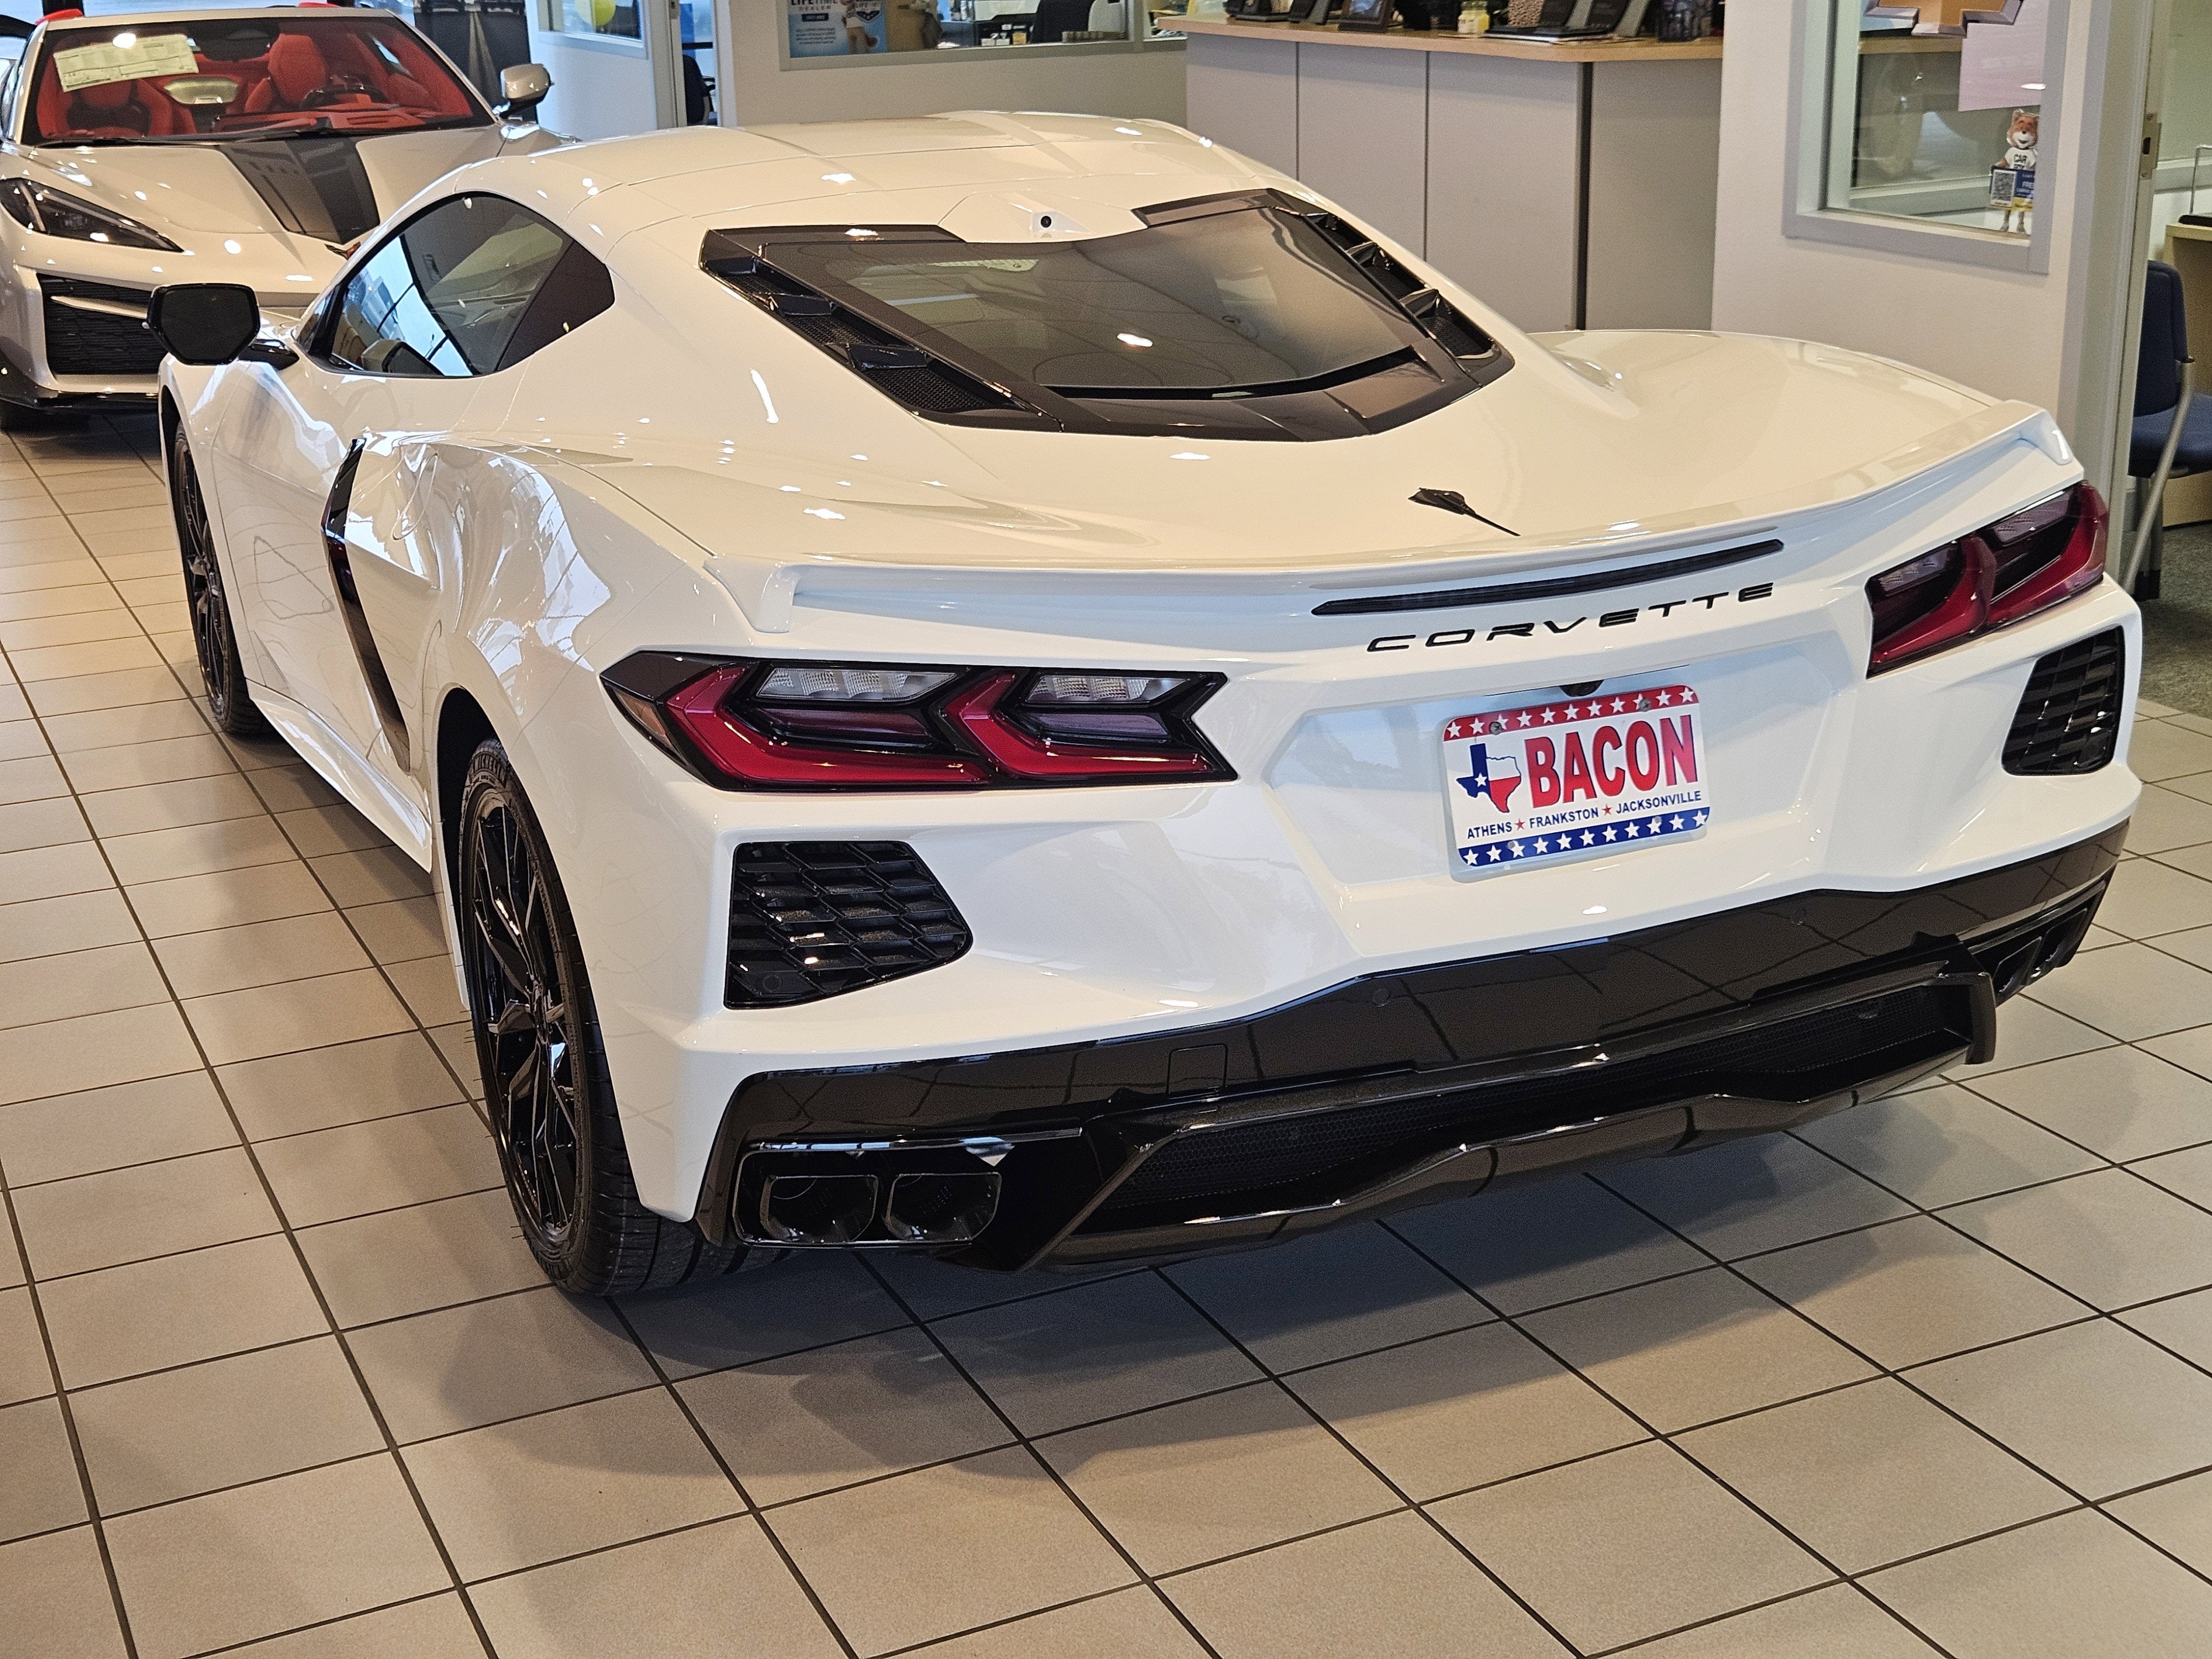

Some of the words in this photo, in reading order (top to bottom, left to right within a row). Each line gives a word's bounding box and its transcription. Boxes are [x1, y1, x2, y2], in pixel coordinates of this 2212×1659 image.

[1367, 582, 1773, 652] CORVETTE
[1524, 714, 1698, 808] BACON
[1467, 822, 1512, 839] ATHENS
[1529, 807, 1599, 829] FRANKSTON
[1616, 790, 1702, 815] JACKSONVILLE
